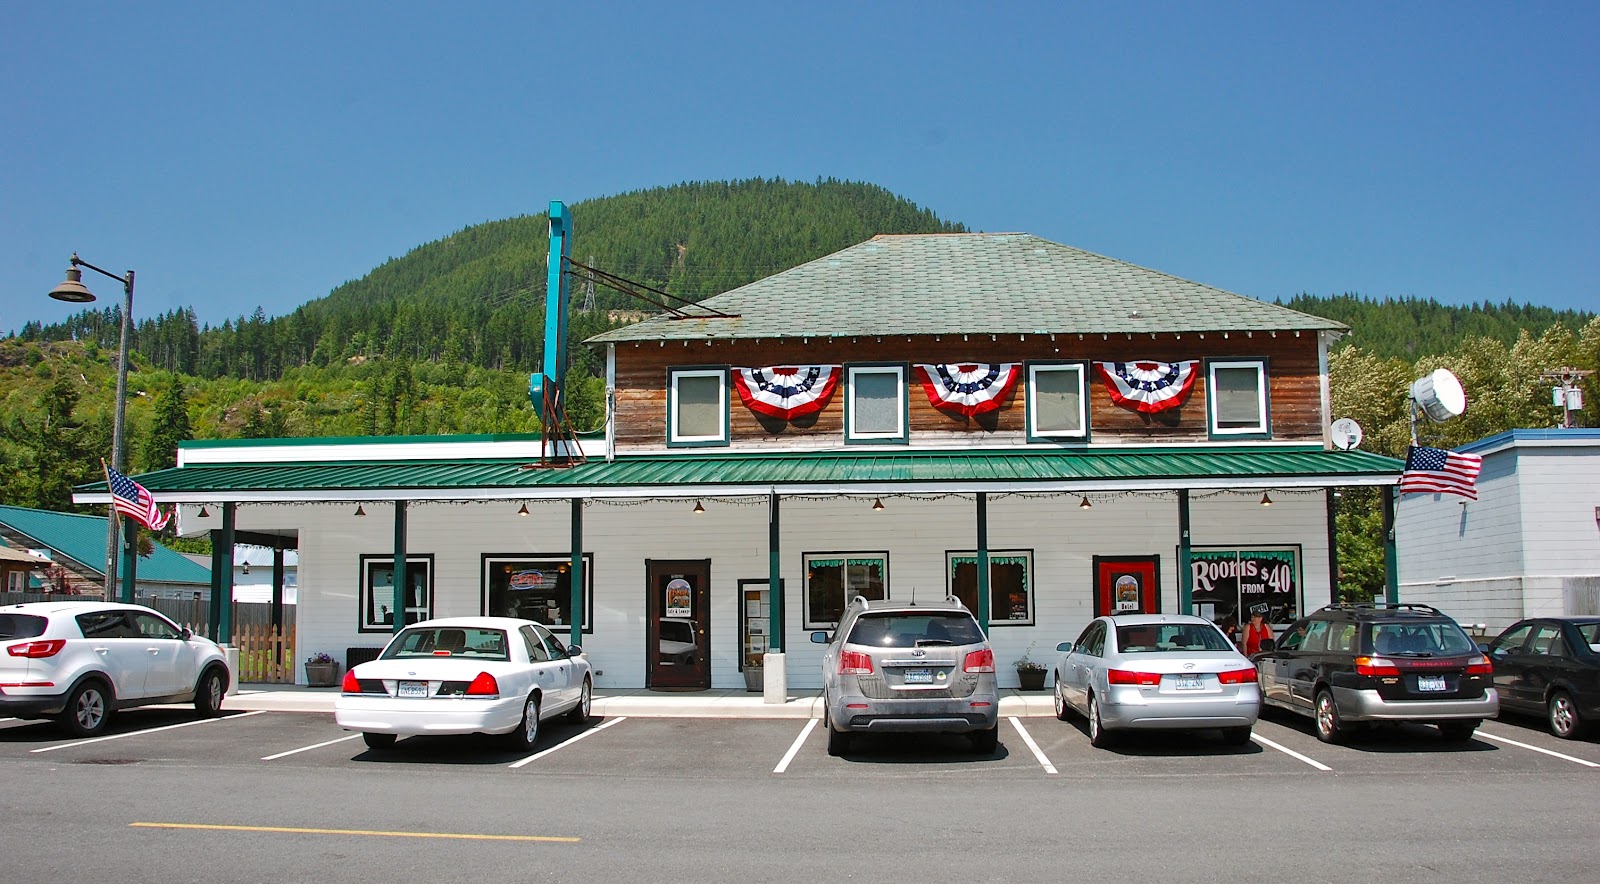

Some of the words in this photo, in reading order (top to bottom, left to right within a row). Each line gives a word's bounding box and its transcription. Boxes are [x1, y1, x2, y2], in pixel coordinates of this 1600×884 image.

[1191, 560, 1258, 592] Rooms
[1261, 564, 1291, 593] $40
[1241, 583, 1265, 594] FROM
